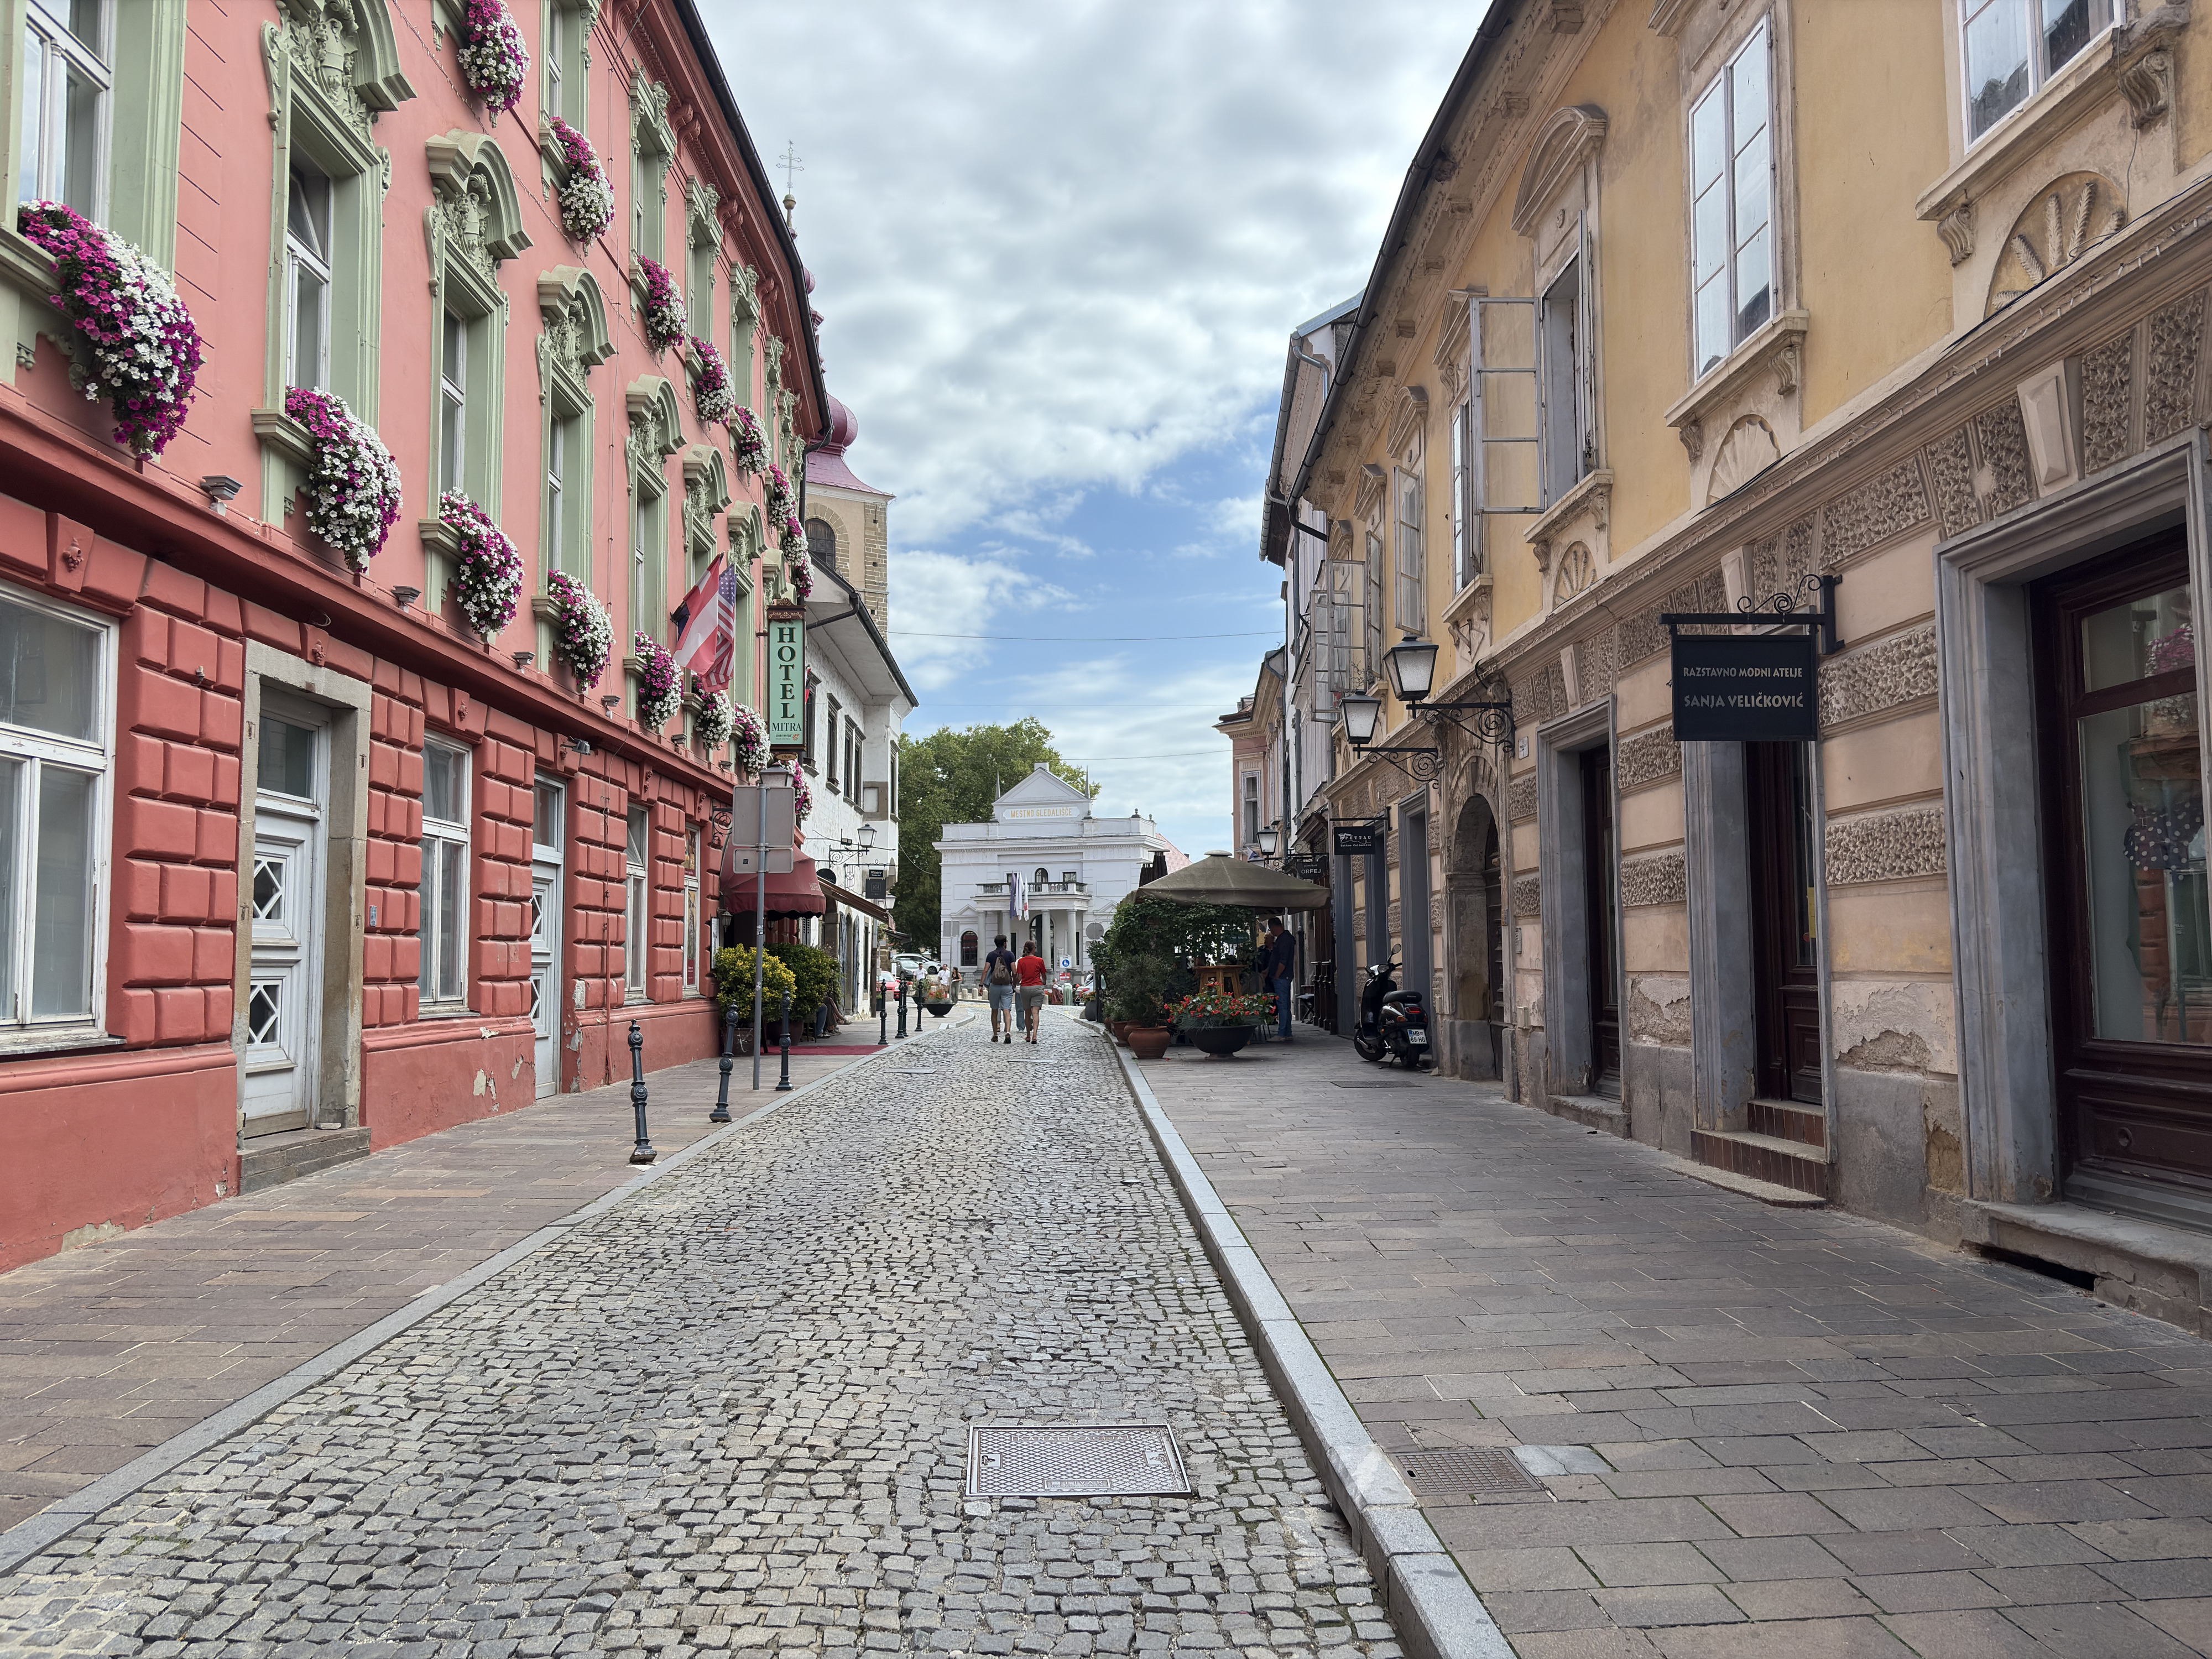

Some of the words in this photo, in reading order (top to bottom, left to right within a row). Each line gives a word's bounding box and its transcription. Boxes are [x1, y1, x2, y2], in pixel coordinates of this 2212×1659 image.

[777, 627, 796, 718] HOTEL
[1683, 667, 1737, 677] RAZSTAVNO
[1739, 667, 1771, 677] MODNI
[1773, 667, 1802, 678] ATELJE
[1684, 695, 1725, 709] SANJA
[1728, 692, 1804, 708] VELIČKOVIĆ
[771, 722, 802, 731] MITRA
[1011, 810, 1034, 818] MESTNO
[1036, 807, 1072, 817] GLEDALIŠČE
